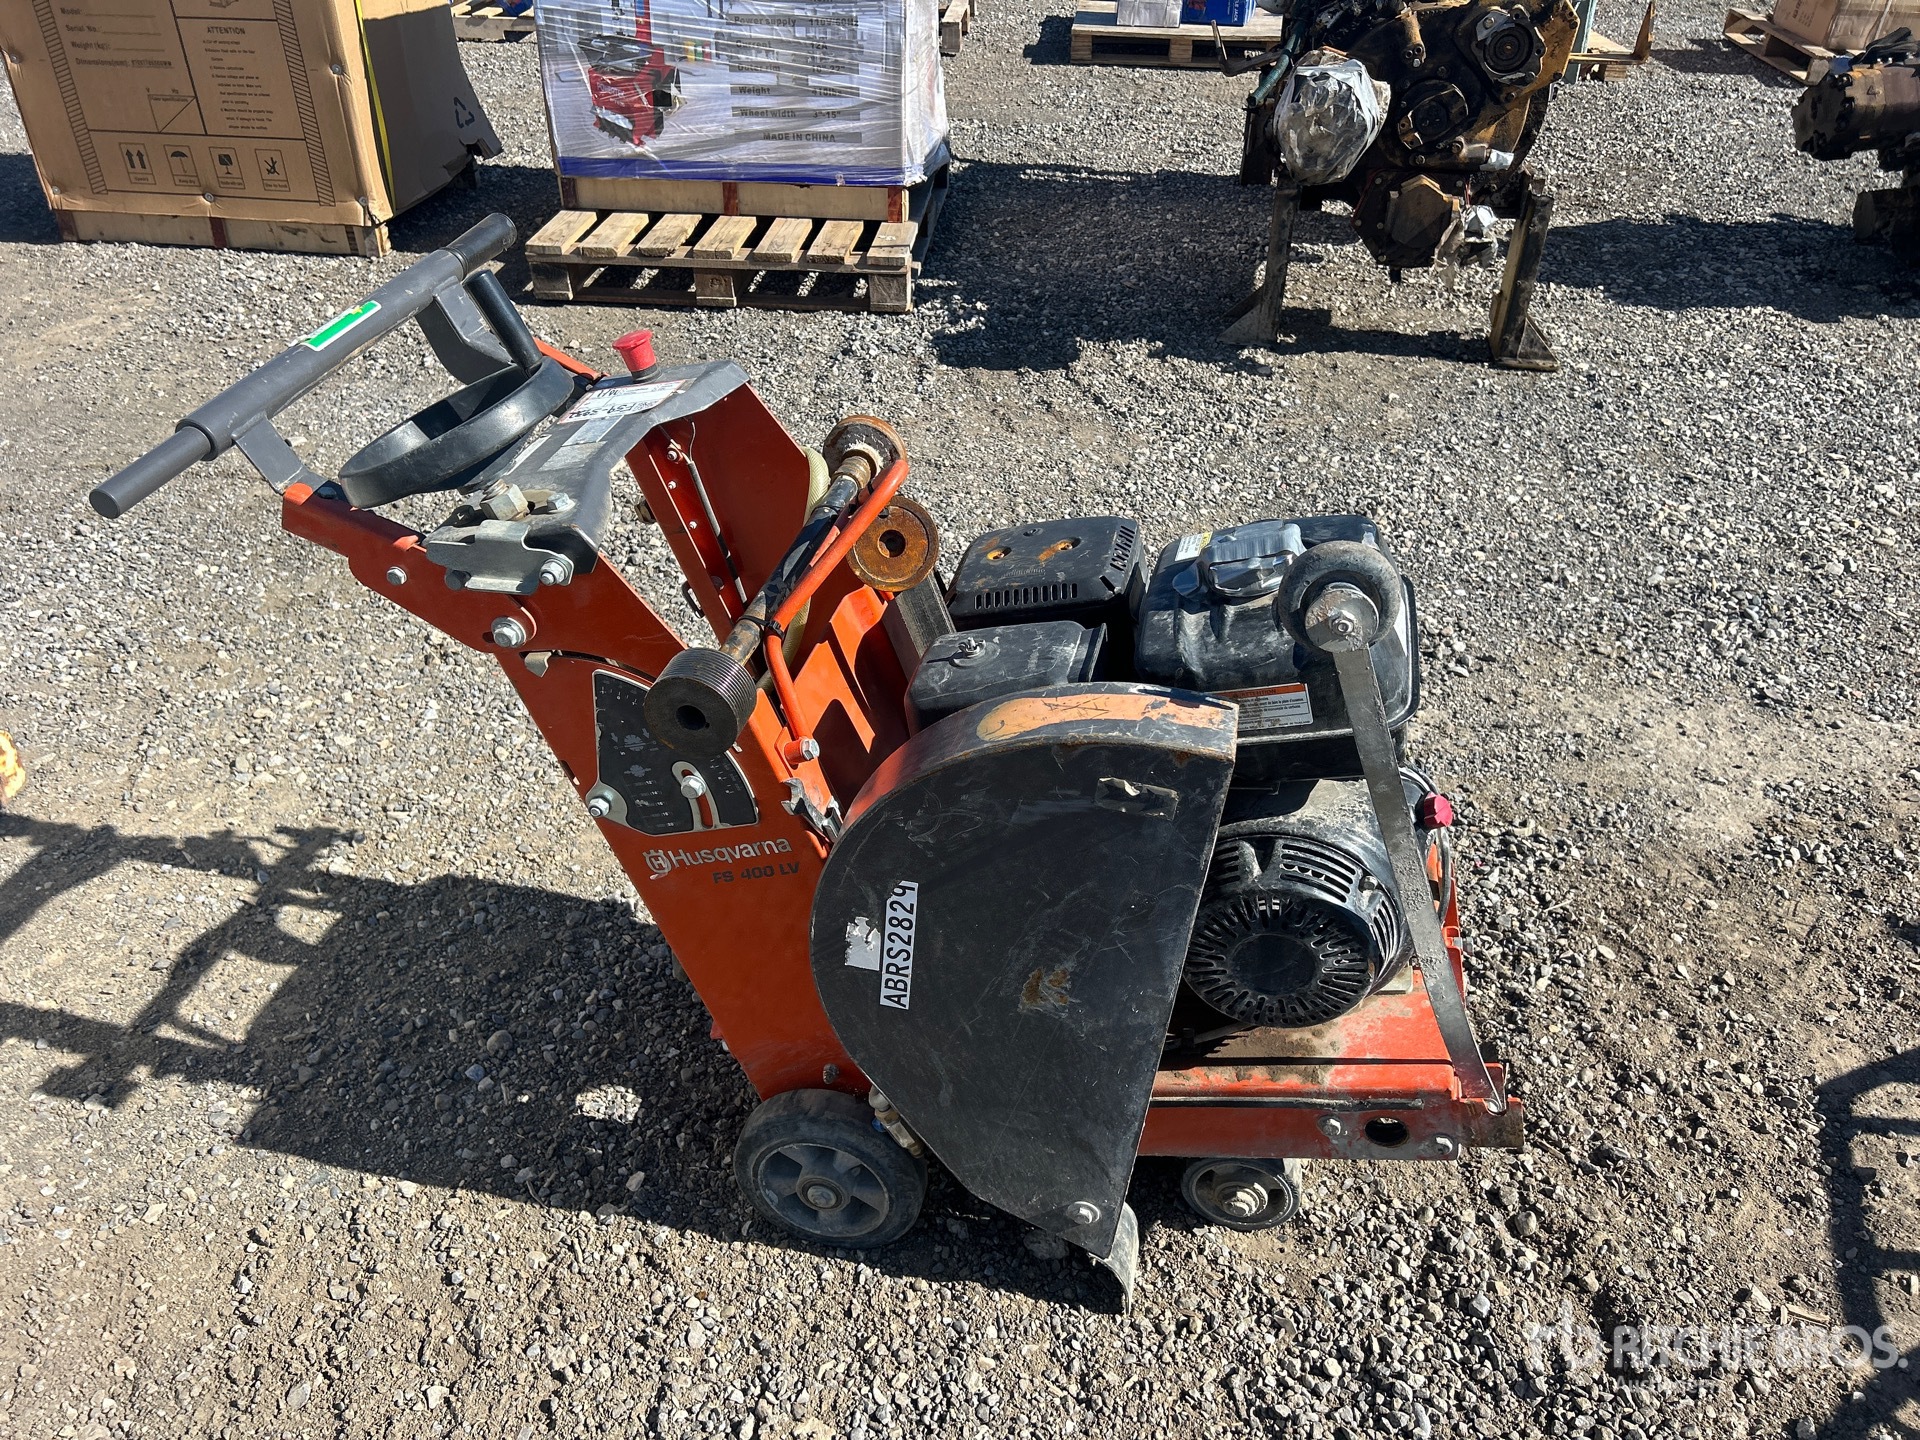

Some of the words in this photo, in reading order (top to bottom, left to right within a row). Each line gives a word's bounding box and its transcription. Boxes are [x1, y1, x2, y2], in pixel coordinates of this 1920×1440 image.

[734, 16, 764, 25] Power
[765, 17, 796, 27] supply
[207, 26, 246, 35] ATTENTION
[735, 40, 772, 48] Current
[738, 86, 771, 96] Weight
[740, 109, 768, 118] Wheel
[771, 109, 796, 118] width
[763, 132, 790, 141] MADE
[792, 133, 802, 141] IN
[805, 133, 836, 142] CHINA
[668, 838, 792, 868] Husqvarna
[712, 870, 735, 884] FS
[740, 865, 775, 880] 400
[779, 862, 800, 875] LV
